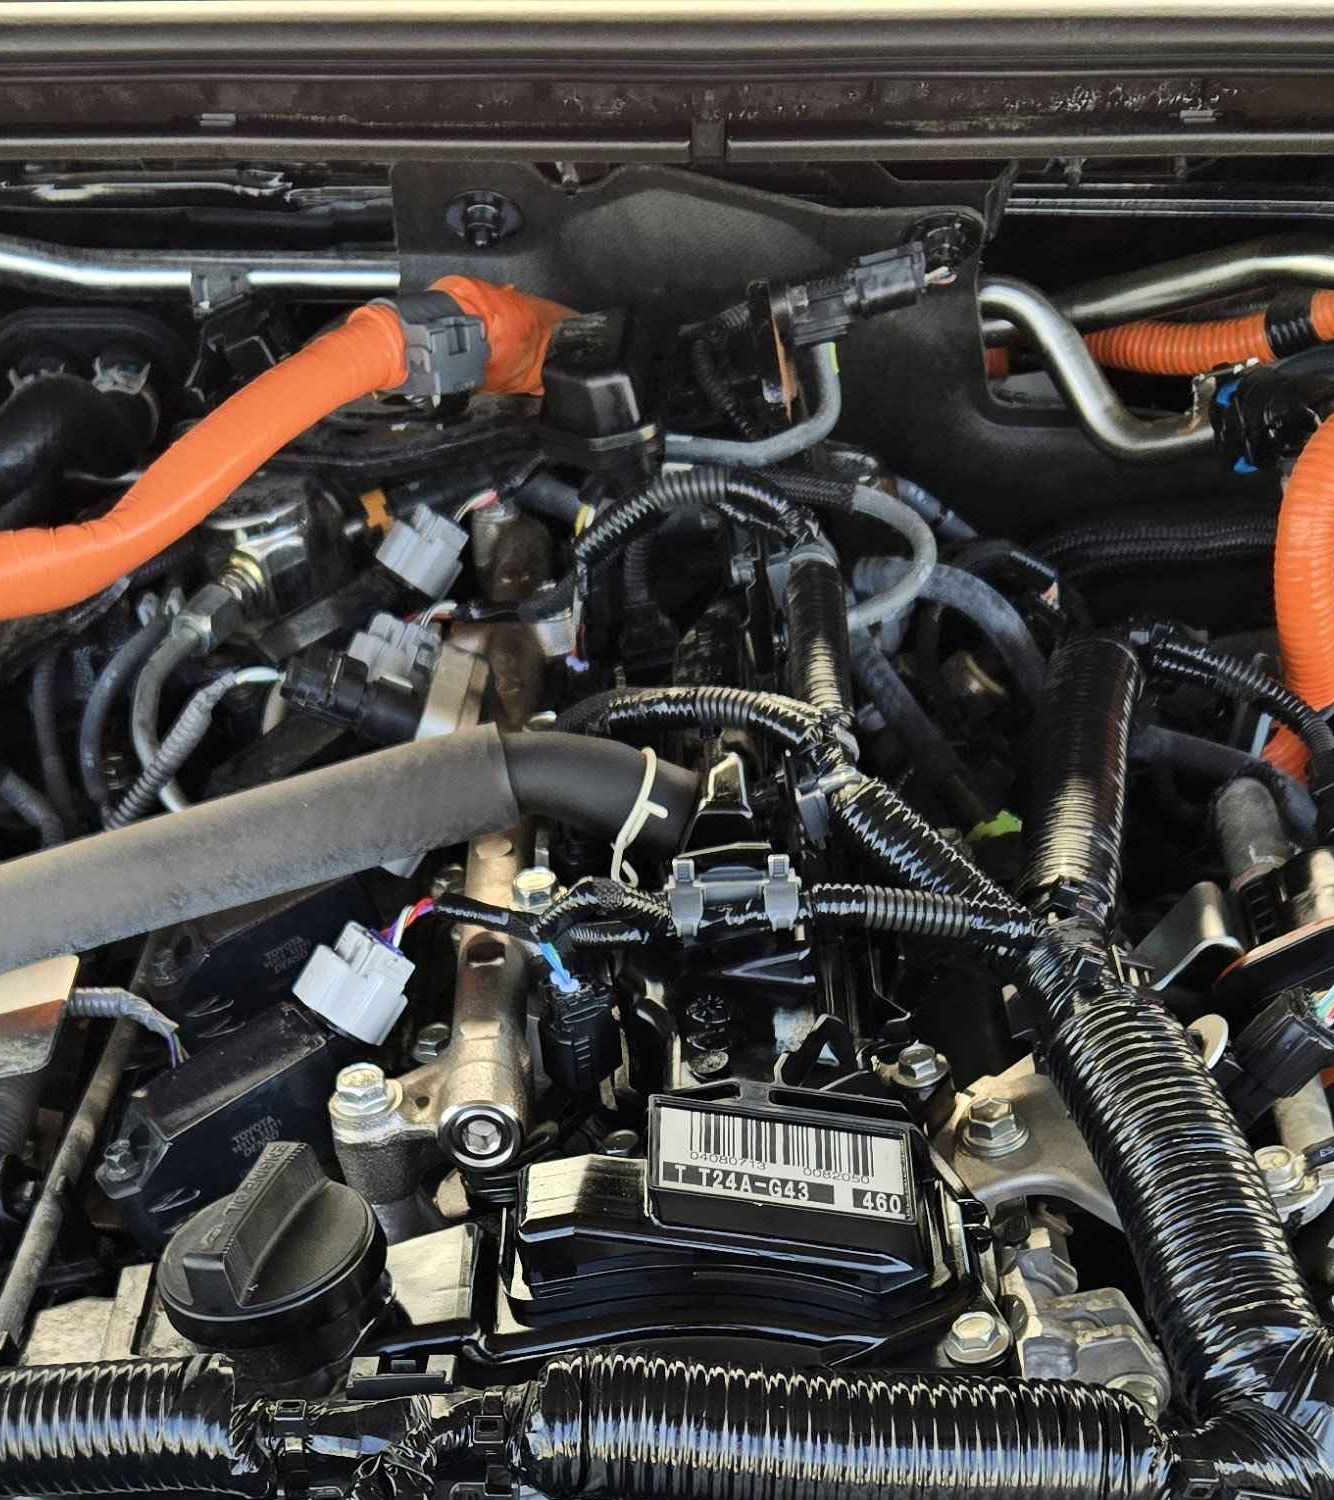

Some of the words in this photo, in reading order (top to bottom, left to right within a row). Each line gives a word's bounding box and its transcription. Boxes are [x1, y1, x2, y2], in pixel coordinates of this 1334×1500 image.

[264, 936, 305, 960] TOYOTA
[232, 1115, 275, 1145] TOYOTA
[243, 1130, 280, 1158] DENSO
[242, 1143, 289, 1191] ENGINE
[689, 1150, 767, 1171] 04080713
[802, 1167, 871, 1185] 0082050
[222, 1192, 250, 1216] OIL
[675, 1164, 687, 1183] T
[698, 1167, 810, 1202] T24A-G43
[862, 1191, 902, 1215] 460
